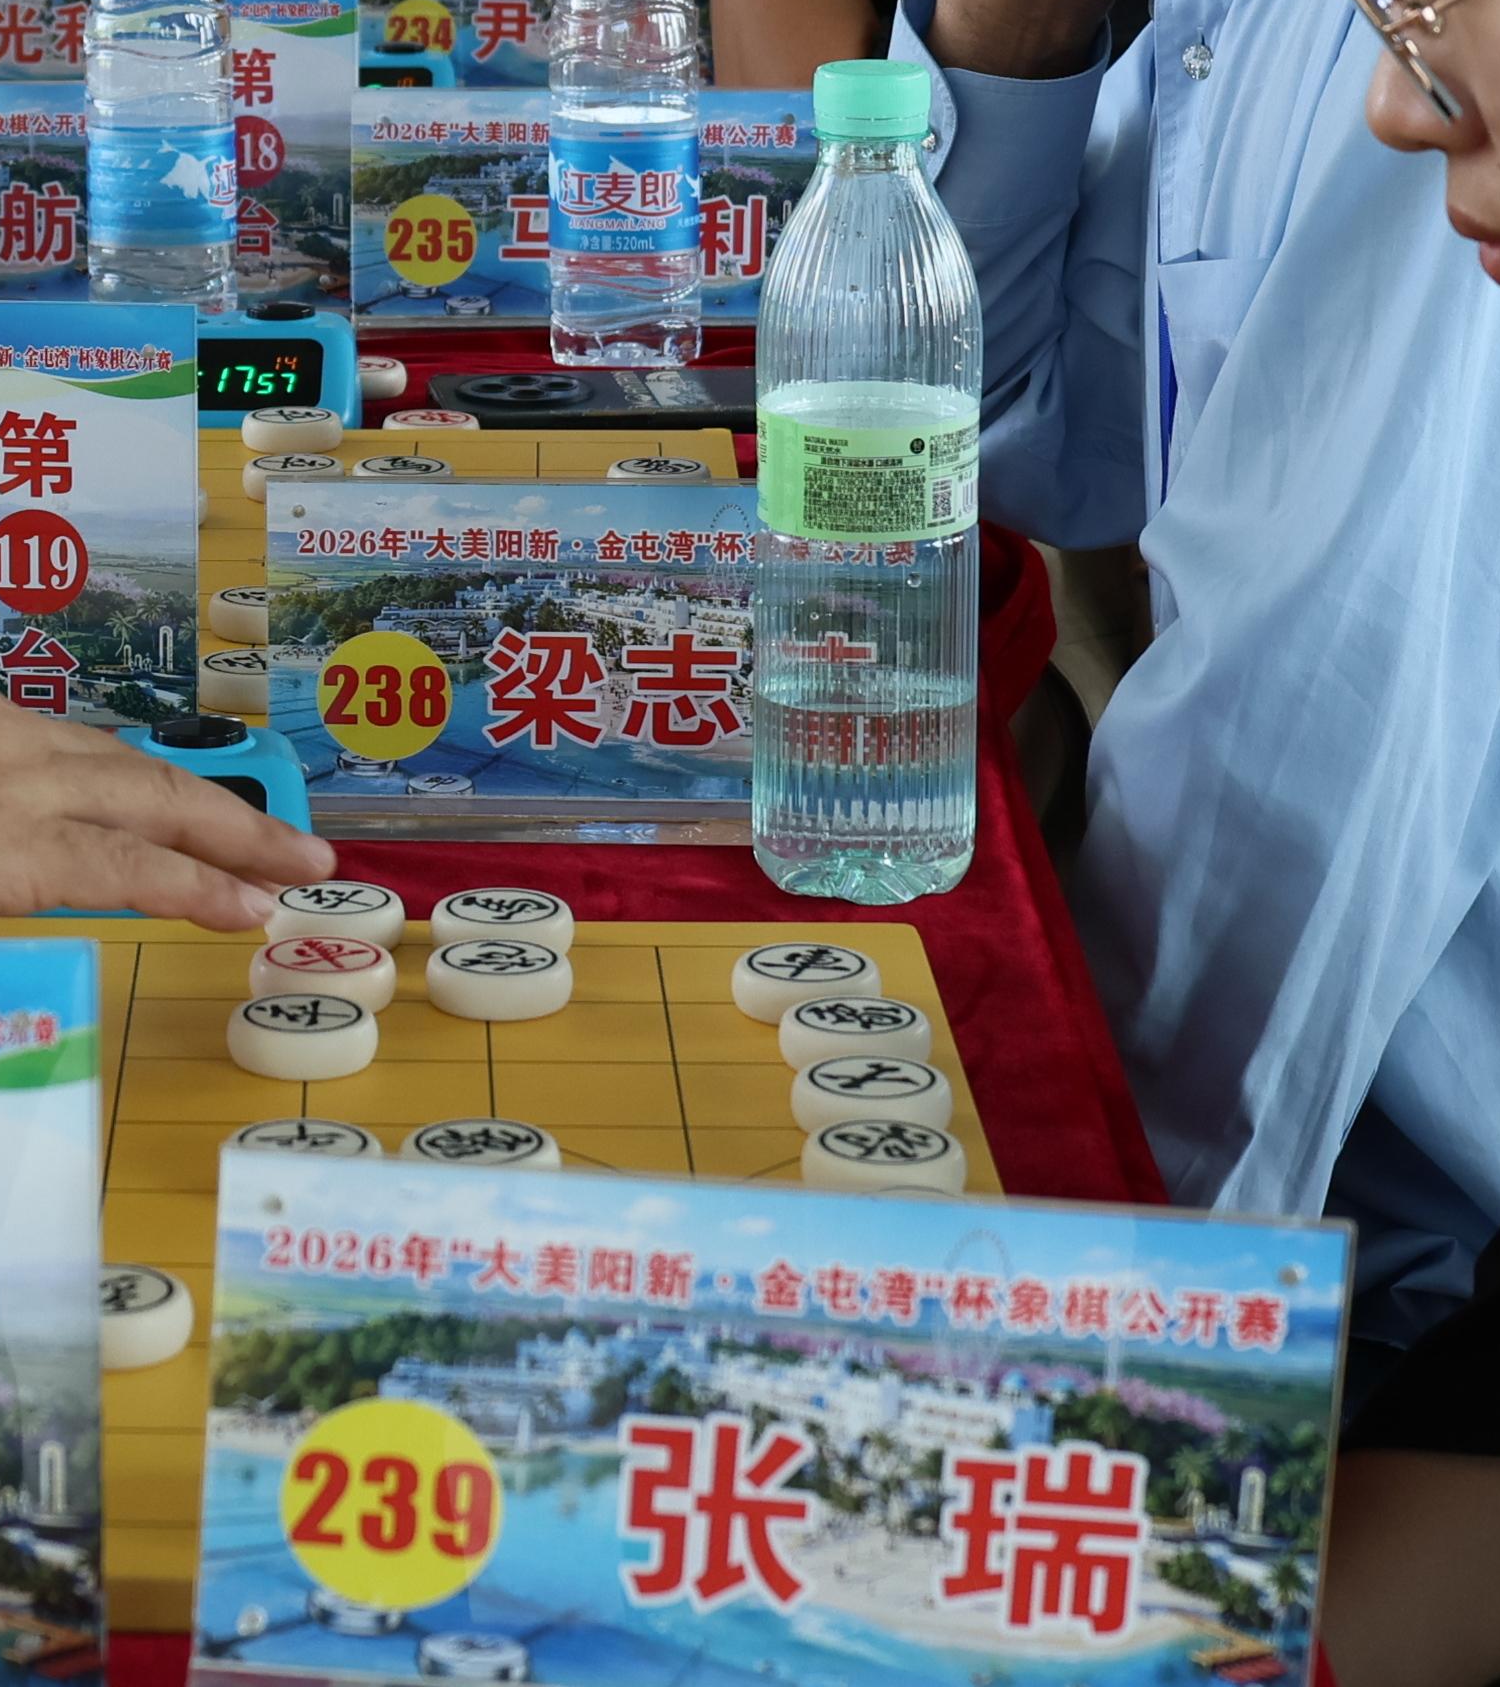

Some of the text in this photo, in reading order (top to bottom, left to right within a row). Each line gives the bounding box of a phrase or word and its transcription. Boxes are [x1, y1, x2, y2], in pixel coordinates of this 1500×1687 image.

[233, 48, 279, 256] 第 18 台
[562, 172, 677, 210] 江麦郎
[388, 217, 474, 264] 235
[569, 217, 667, 231] JIANGMAILANG
[274, 356, 298, 370] 14
[0, 628, 79, 715] 台
[323, 664, 448, 727] 238
[486, 630, 746, 748] 梁志
[291, 1449, 496, 1558] 239
